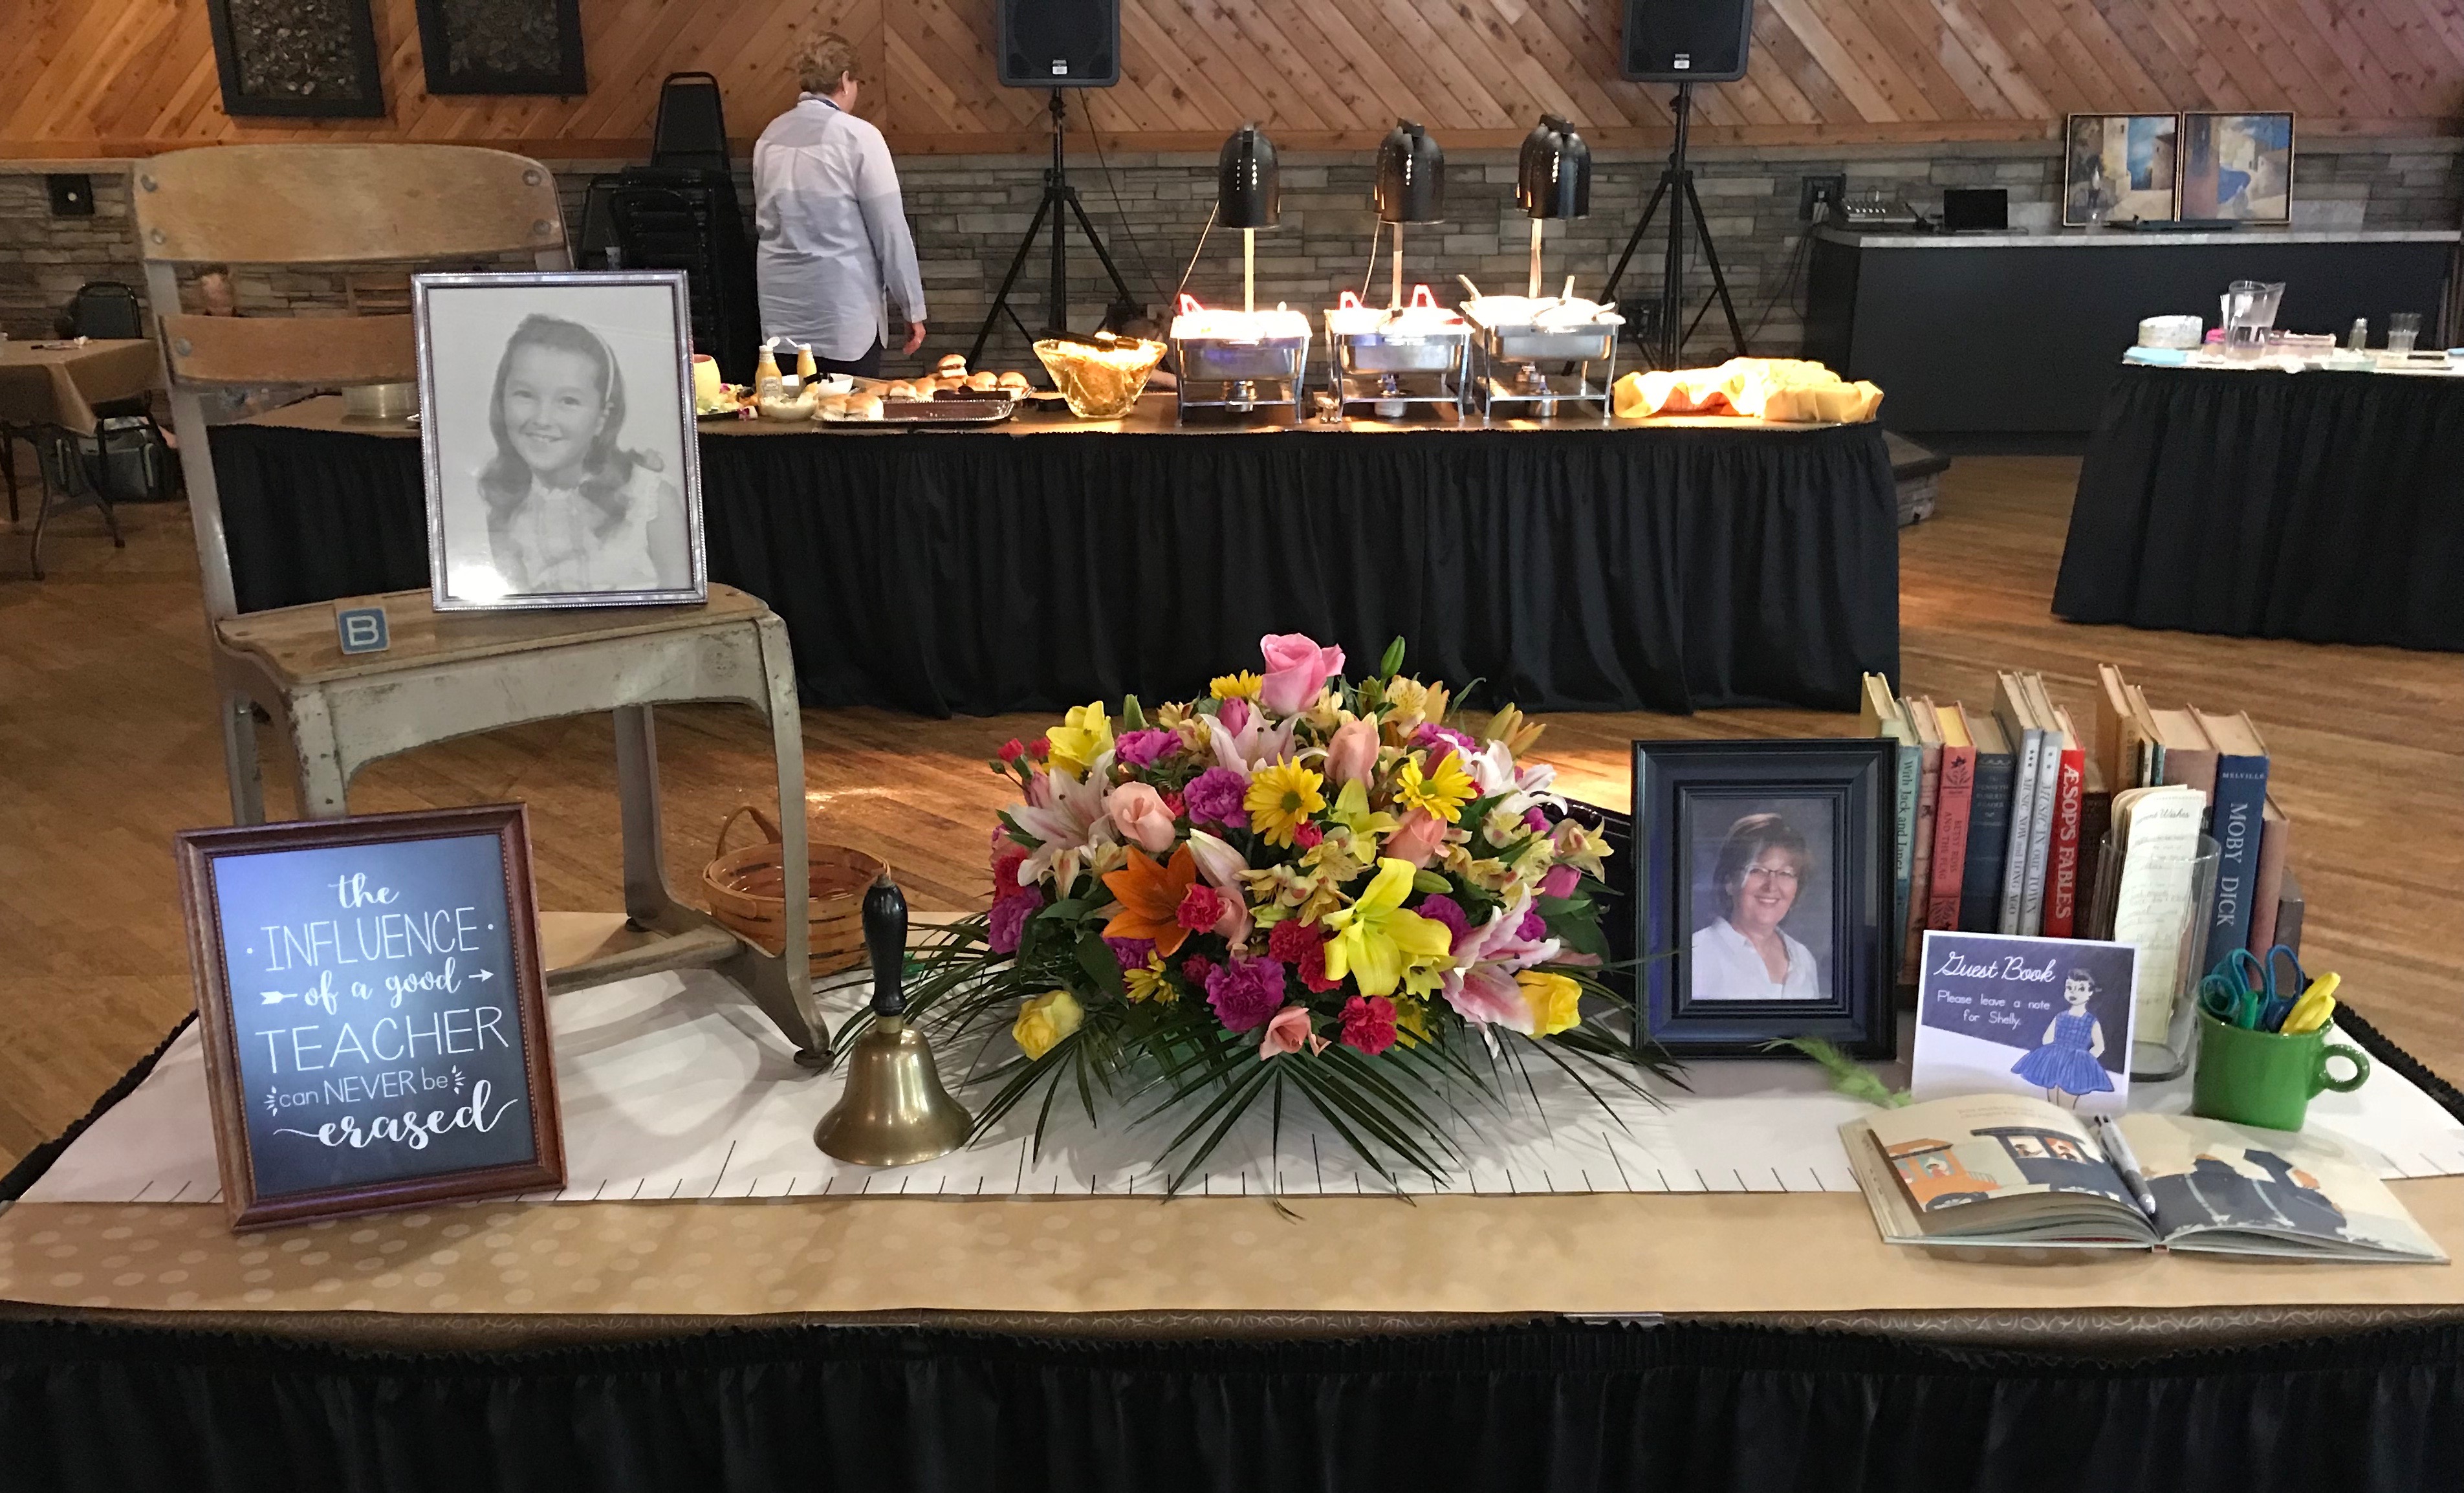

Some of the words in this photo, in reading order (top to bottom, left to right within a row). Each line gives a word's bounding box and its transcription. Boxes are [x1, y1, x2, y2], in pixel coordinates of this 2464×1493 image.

[346, 615, 380, 646] B
[1903, 761, 1913, 785] With
[1899, 790, 1912, 812] Jack
[2021, 778, 2033, 811] MUSIC
[2038, 783, 2051, 827] MUSIC
[1897, 817, 1908, 837] and
[1943, 811, 1952, 832] AND
[2017, 816, 2028, 838] NOW
[2224, 802, 2249, 864] MOBY
[1941, 836, 1950, 854] THE
[2035, 831, 2046, 844] IN
[327, 872, 399, 908] the
[2011, 860, 2023, 889] LONG
[2055, 846, 2075, 919] FABLES
[2007, 894, 2018, 915] AGO
[2026, 875, 2040, 914] TOWN
[2216, 875, 2240, 927] DICK
[261, 907, 479, 972] INFLUENCE
[1934, 952, 1999, 978] Guest
[2001, 956, 2056, 983] Book
[304, 970, 339, 1014] of
[351, 979, 373, 1000] a
[384, 956, 462, 1007] good
[1937, 989, 1972, 1005] Please
[1980, 994, 2005, 1007] leave
[2013, 1000, 2020, 1008] a
[2028, 999, 2051, 1010] note
[1963, 1009, 1980, 1022] for
[255, 1005, 509, 1074] TEACHER
[279, 1089, 320, 1108] can
[323, 1070, 417, 1105] NEVER
[422, 1067, 449, 1091] be
[273, 1079, 518, 1150] erased
